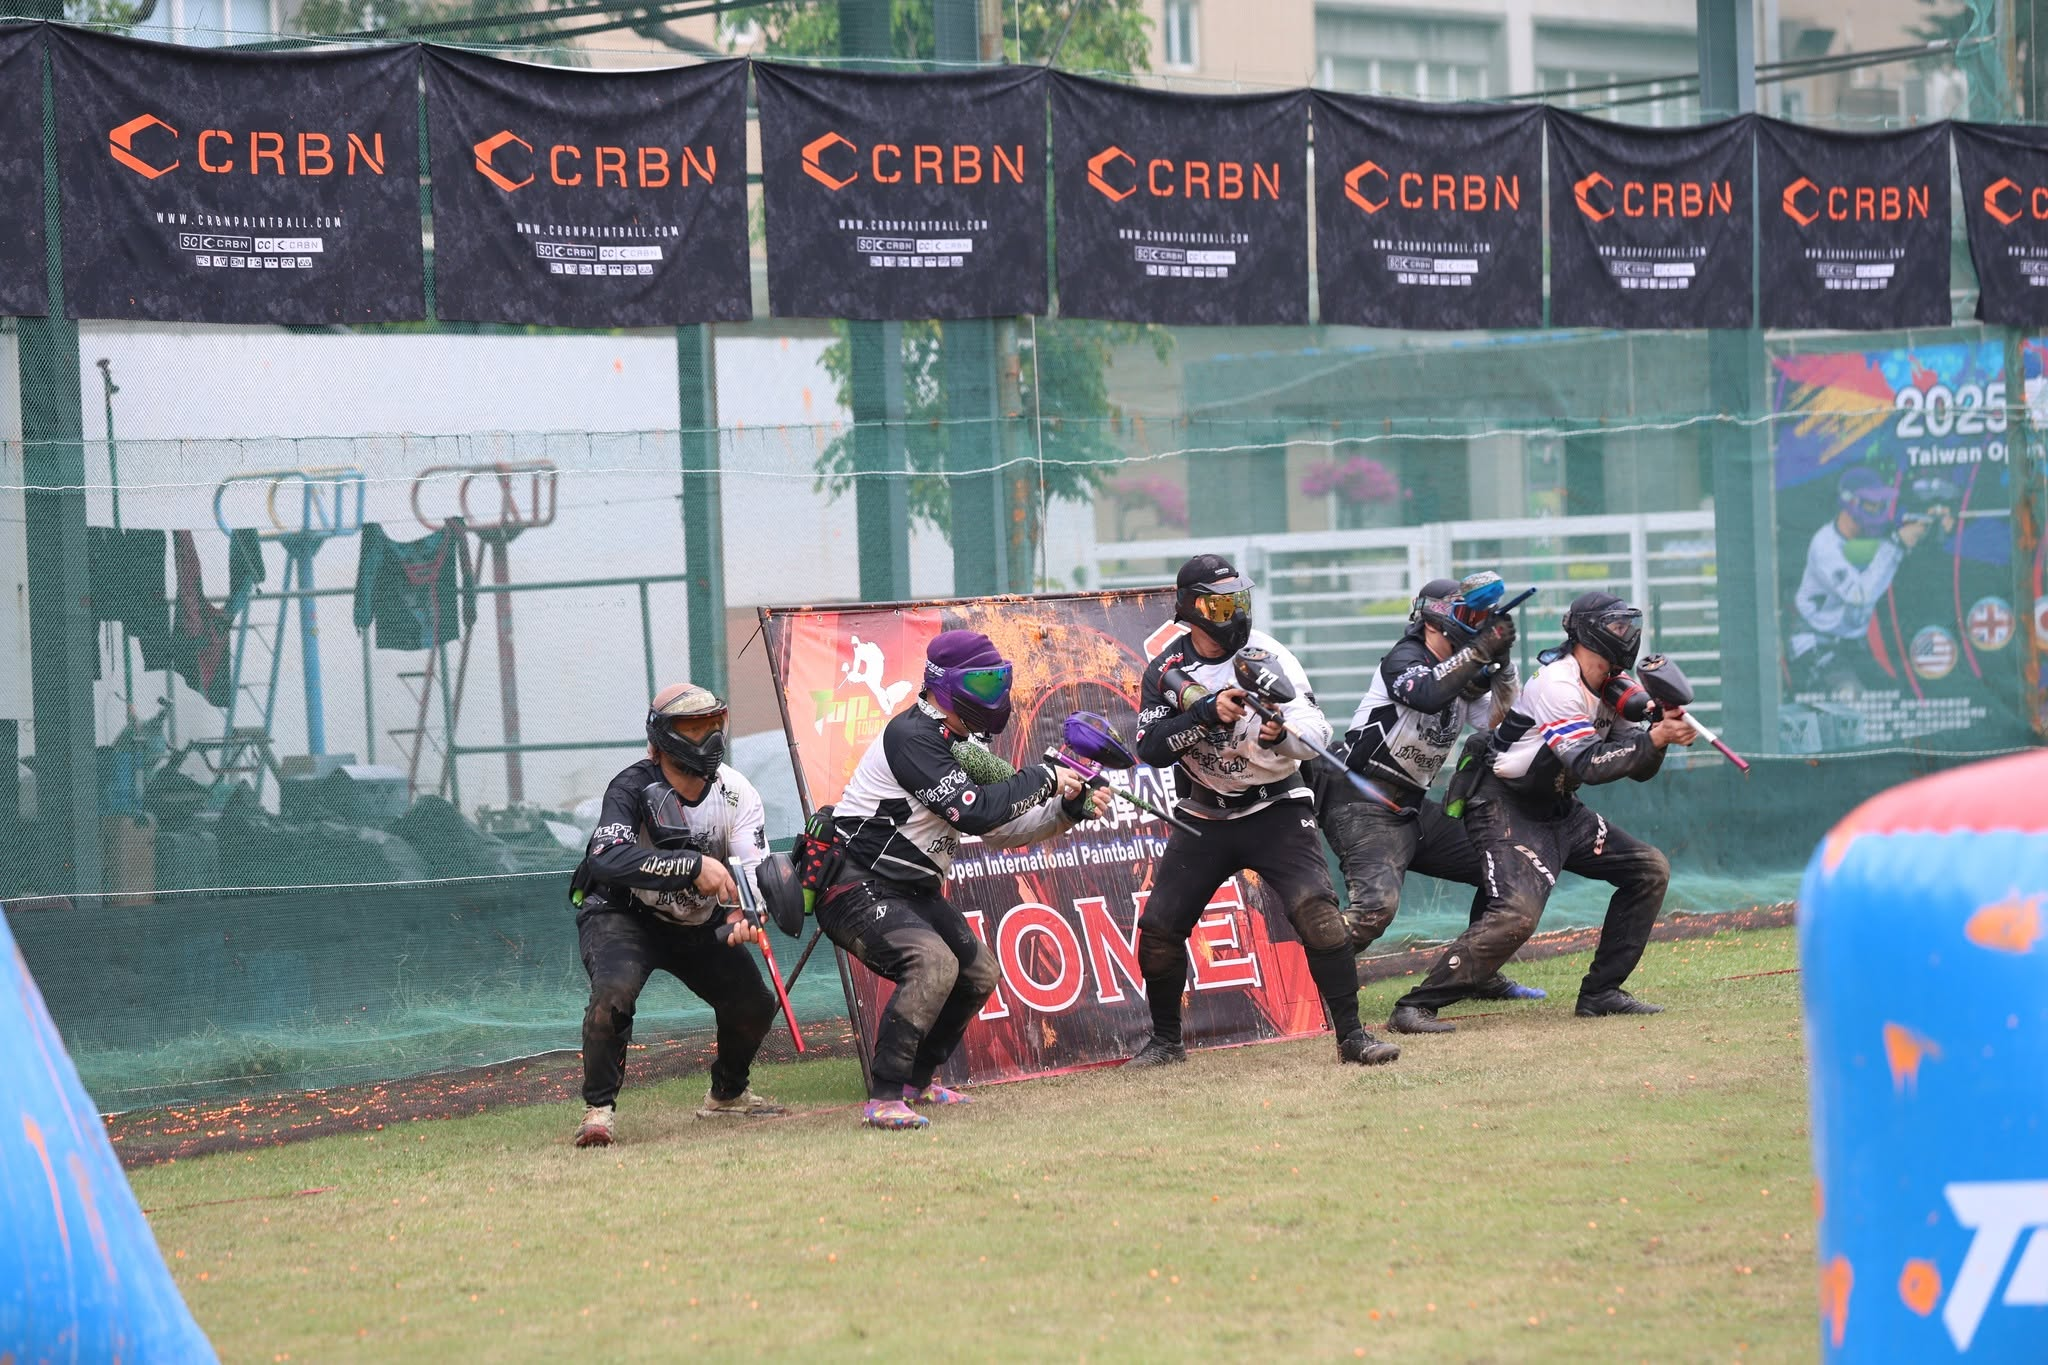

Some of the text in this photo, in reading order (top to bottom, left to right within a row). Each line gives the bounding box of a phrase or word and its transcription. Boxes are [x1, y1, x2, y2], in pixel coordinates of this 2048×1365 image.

[198, 130, 384, 176] CRBN
[550, 145, 716, 187] CRBN
[872, 144, 1023, 184] CRBN
[1149, 160, 1279, 200] CRBN
[1400, 173, 1519, 211] CRBN
[1624, 182, 1732, 218] CRBN
[1829, 186, 1928, 221] CRBN
[157, 212, 342, 228] WWW.CRBNPAINTBALL.COM
[517, 222, 679, 237] WWW.CRBNPAINTBALL.COM
[839, 219, 988, 231] WWW.CRBNPAINTBALL.COM
[183, 236, 248, 249] SC CRBN
[257, 240, 271, 250] CC
[539, 245, 594, 257] SC CRBN
[860, 240, 912, 250] SC CRBN
[1896, 382, 2007, 438] 2025
[1907, 444, 1982, 467] Taiwan
[1255, 667, 1279, 691] 77
[986, 846, 1079, 876] International
[1082, 838, 1144, 865] Paintball
